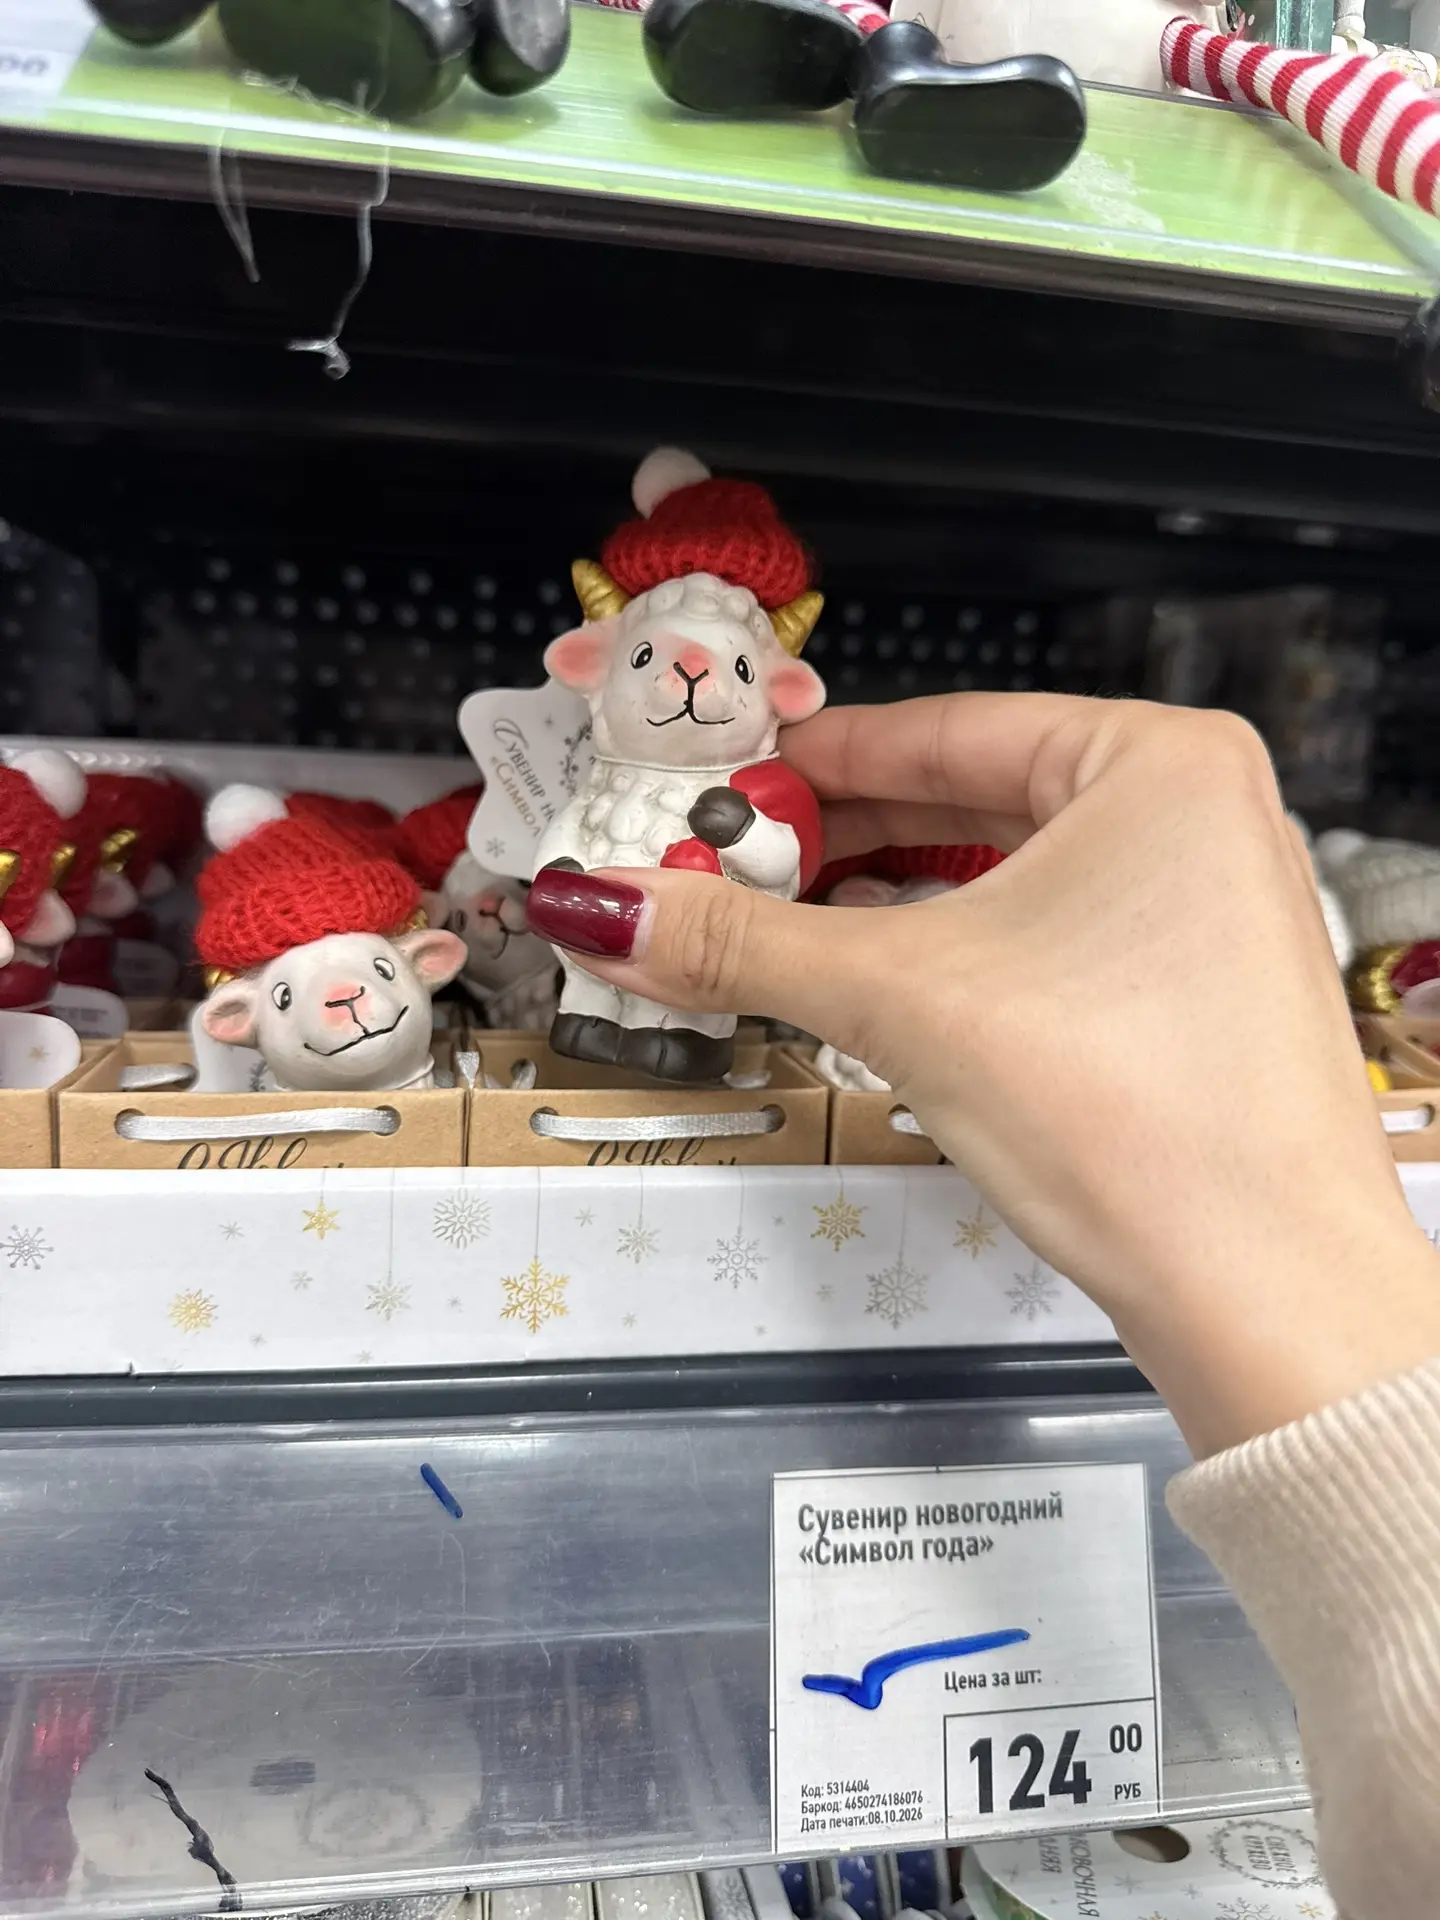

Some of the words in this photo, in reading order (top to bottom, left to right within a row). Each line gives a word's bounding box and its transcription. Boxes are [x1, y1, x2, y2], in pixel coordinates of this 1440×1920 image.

[798, 1503, 907, 1536] Сувенир
[916, 1491, 1062, 1526] новогодний
[799, 1536, 913, 1565] «Символ
[923, 1537, 994, 1561] года»
[944, 1671, 987, 1692] Цена
[992, 1673, 1010, 1687] за
[1109, 1723, 1143, 1753] 00
[969, 1729, 1092, 1814] 124
[800, 1784, 824, 1799] Код:
[826, 1779, 869, 1795] 5314404
[1114, 1783, 1142, 1800] РУБ
[801, 1800, 842, 1815] Баркод:
[844, 1791, 924, 1811] 4650274186076
[801, 1816, 825, 1833] Дата
